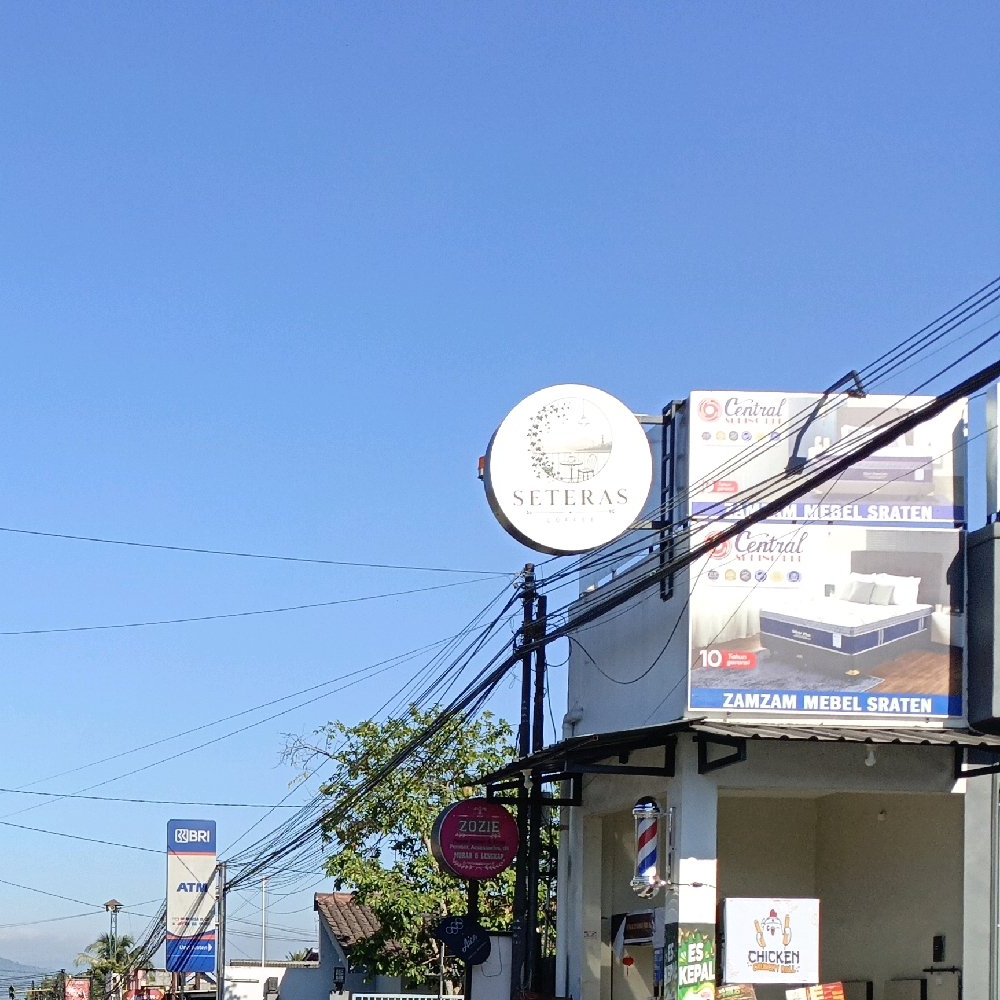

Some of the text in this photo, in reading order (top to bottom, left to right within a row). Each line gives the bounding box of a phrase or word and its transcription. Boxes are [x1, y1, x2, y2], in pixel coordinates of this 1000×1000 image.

[724, 397, 788, 417] Central
[512, 488, 629, 507] SETERAS
[803, 504, 865, 520] MEBEL
[867, 505, 933, 520] SRATEN
[734, 530, 808, 554] Central
[700, 649, 723, 668] 10
[722, 692, 932, 713] ZAMZAM MEBEL SRATEN
[189, 830, 211, 843] BRI
[458, 820, 500, 834] ZOZIE
[176, 882, 209, 893] ATM
[687, 942, 705, 963] ES
[748, 950, 800, 964] CHICKEN
[678, 962, 716, 996] KEPAL
